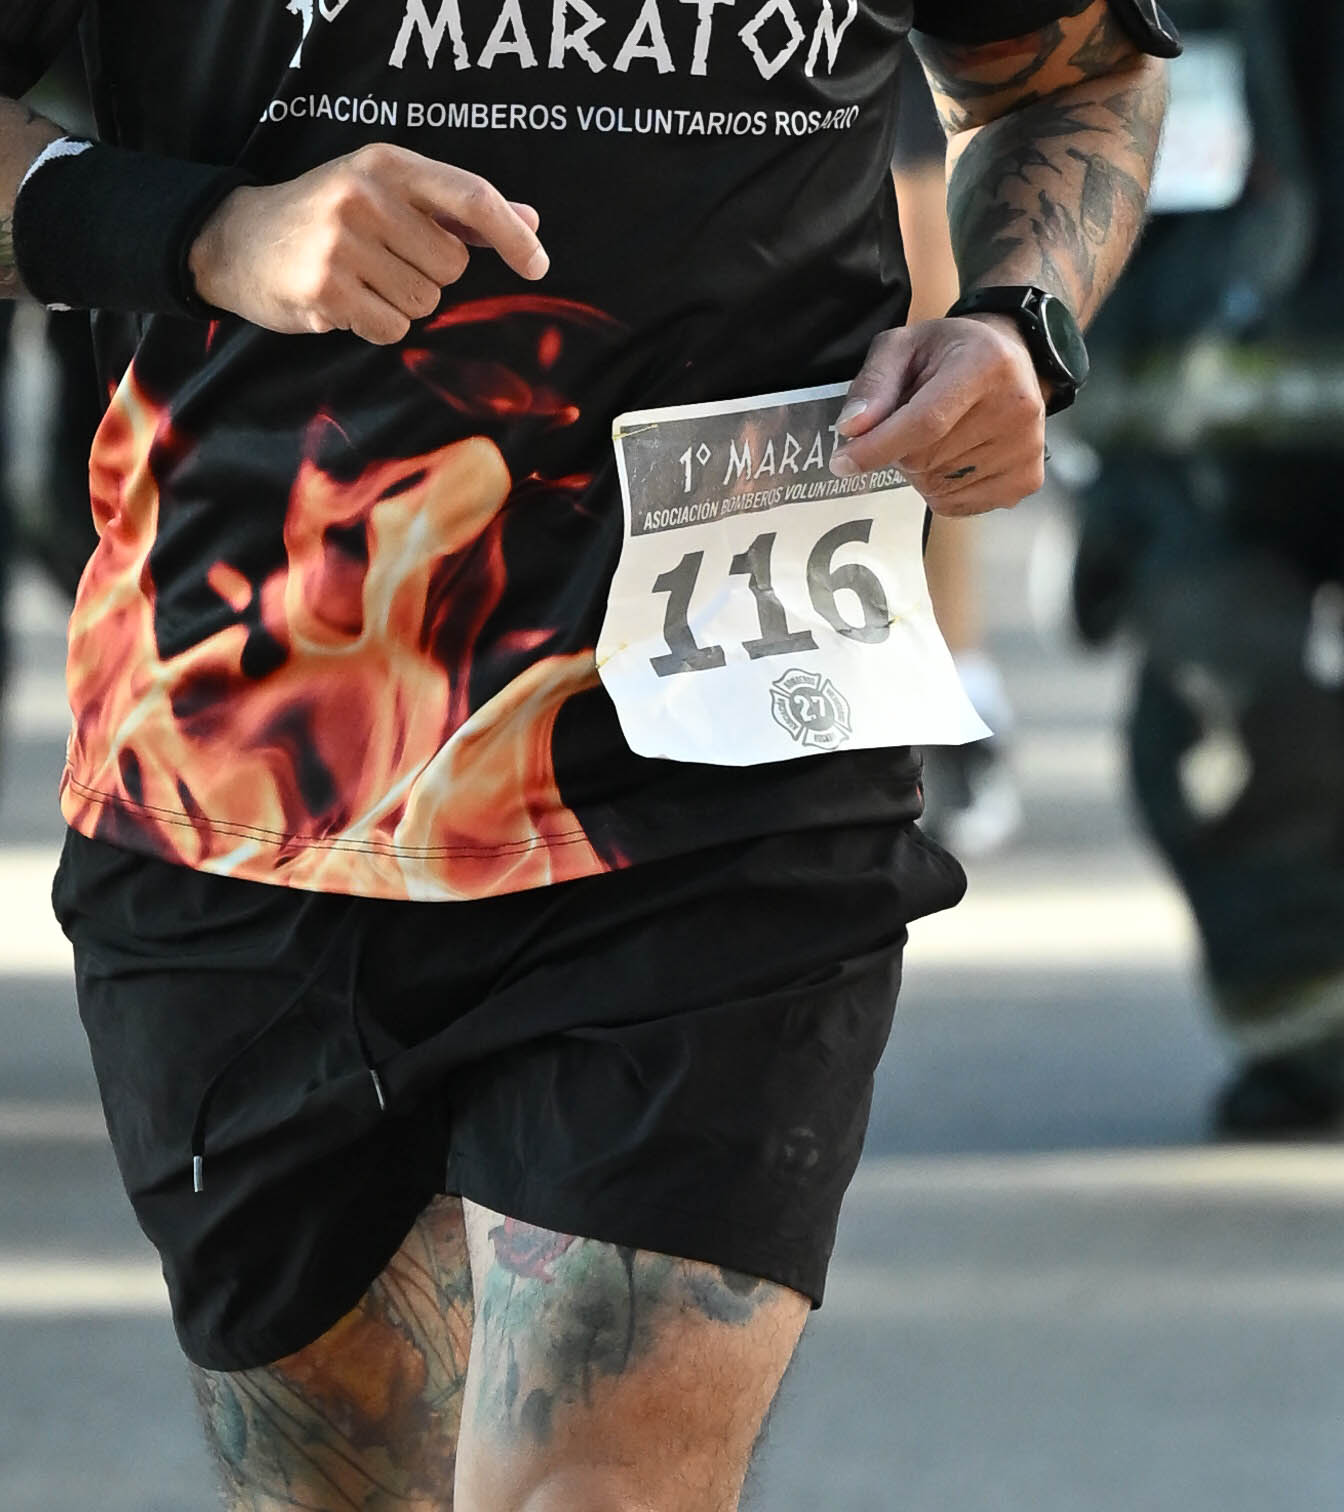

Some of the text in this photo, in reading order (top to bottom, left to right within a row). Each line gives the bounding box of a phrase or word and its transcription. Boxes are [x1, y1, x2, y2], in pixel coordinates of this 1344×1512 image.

[259, 94, 398, 126] OCIACIÓN
[407, 103, 567, 130] BOMBEROS
[577, 106, 766, 135] VOLUNTARIOS
[643, 498, 718, 530] ASOCIACIÓN
[720, 487, 783, 515] BOMBEROS
[784, 474, 867, 501] VOLUNTARIOS
[650, 519, 889, 677] 116
[794, 695, 825, 722] 27
